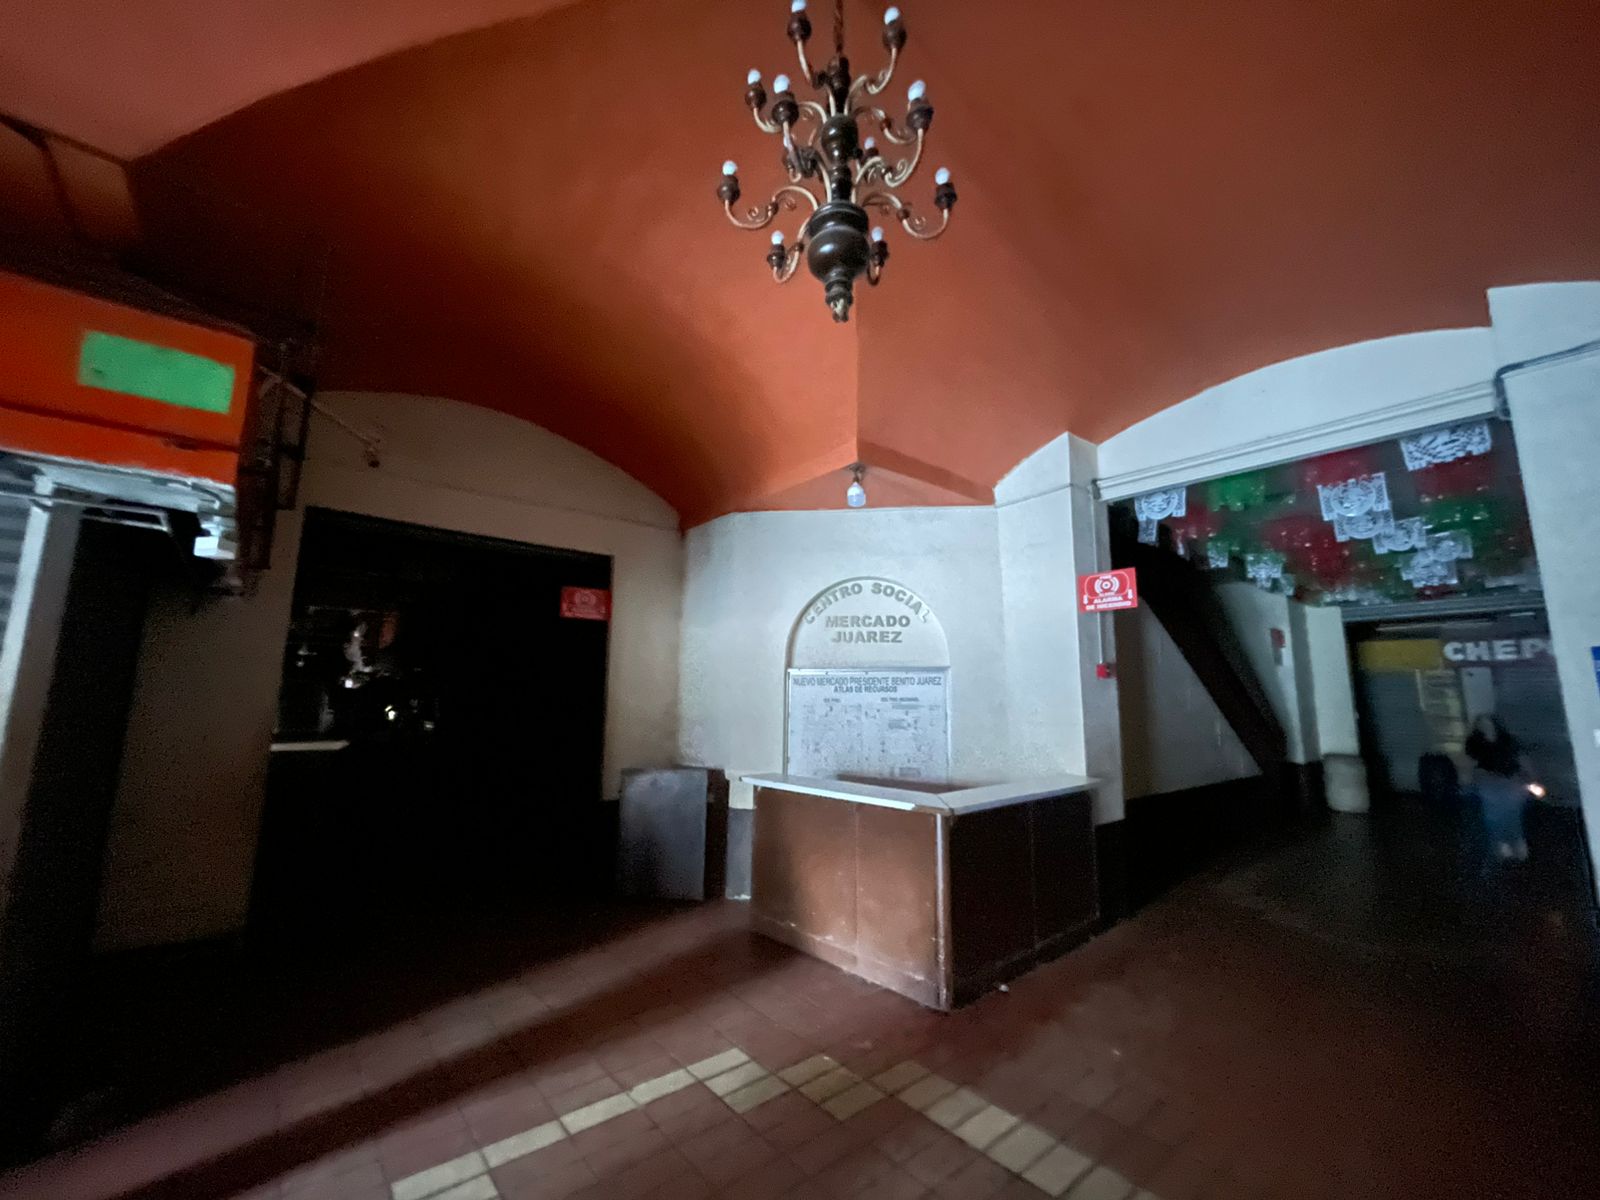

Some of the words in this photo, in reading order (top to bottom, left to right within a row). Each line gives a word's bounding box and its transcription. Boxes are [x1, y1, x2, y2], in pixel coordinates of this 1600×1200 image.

[805, 582, 863, 624] CENTRO
[870, 582, 930, 623] SOCIAL
[825, 615, 911, 628] MERCADO
[831, 631, 903, 643] JUAREZ
[792, 676, 816, 687] NUEVO
[817, 676, 849, 687] MERCADO
[850, 676, 890, 687] PRESIDENTE
[891, 676, 916, 686] BENITO
[917, 676, 942, 686] JUAREZ
[833, 685, 854, 693] ATLAS
[855, 685, 863, 693] DE
[864, 685, 898, 693] RECURSOS
